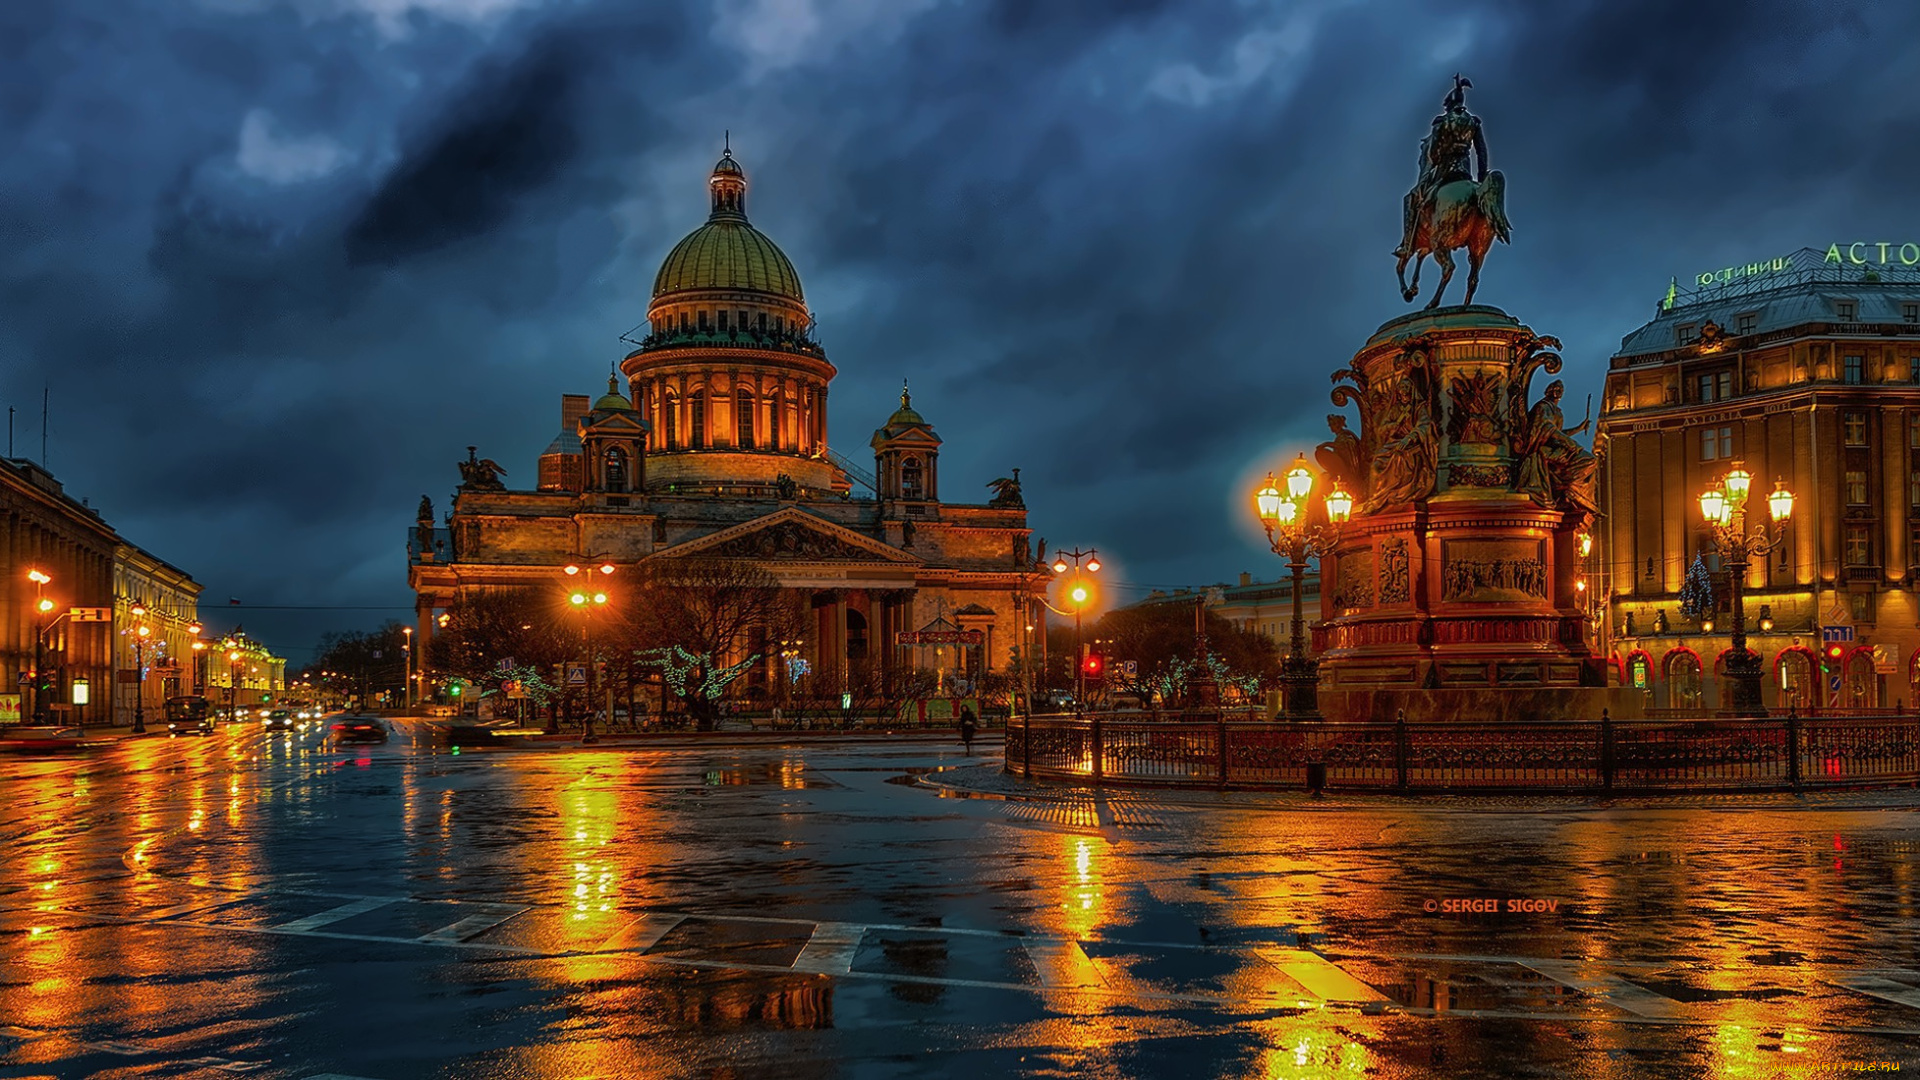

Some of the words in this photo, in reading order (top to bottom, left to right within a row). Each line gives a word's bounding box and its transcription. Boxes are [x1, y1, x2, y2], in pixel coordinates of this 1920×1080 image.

[1695, 256, 1794, 286] ГОСТИНИЦА
[1633, 421, 1660, 432] HOTEL
[1683, 411, 1742, 426] ASTORIA
[1764, 403, 1791, 414] HOTEL
